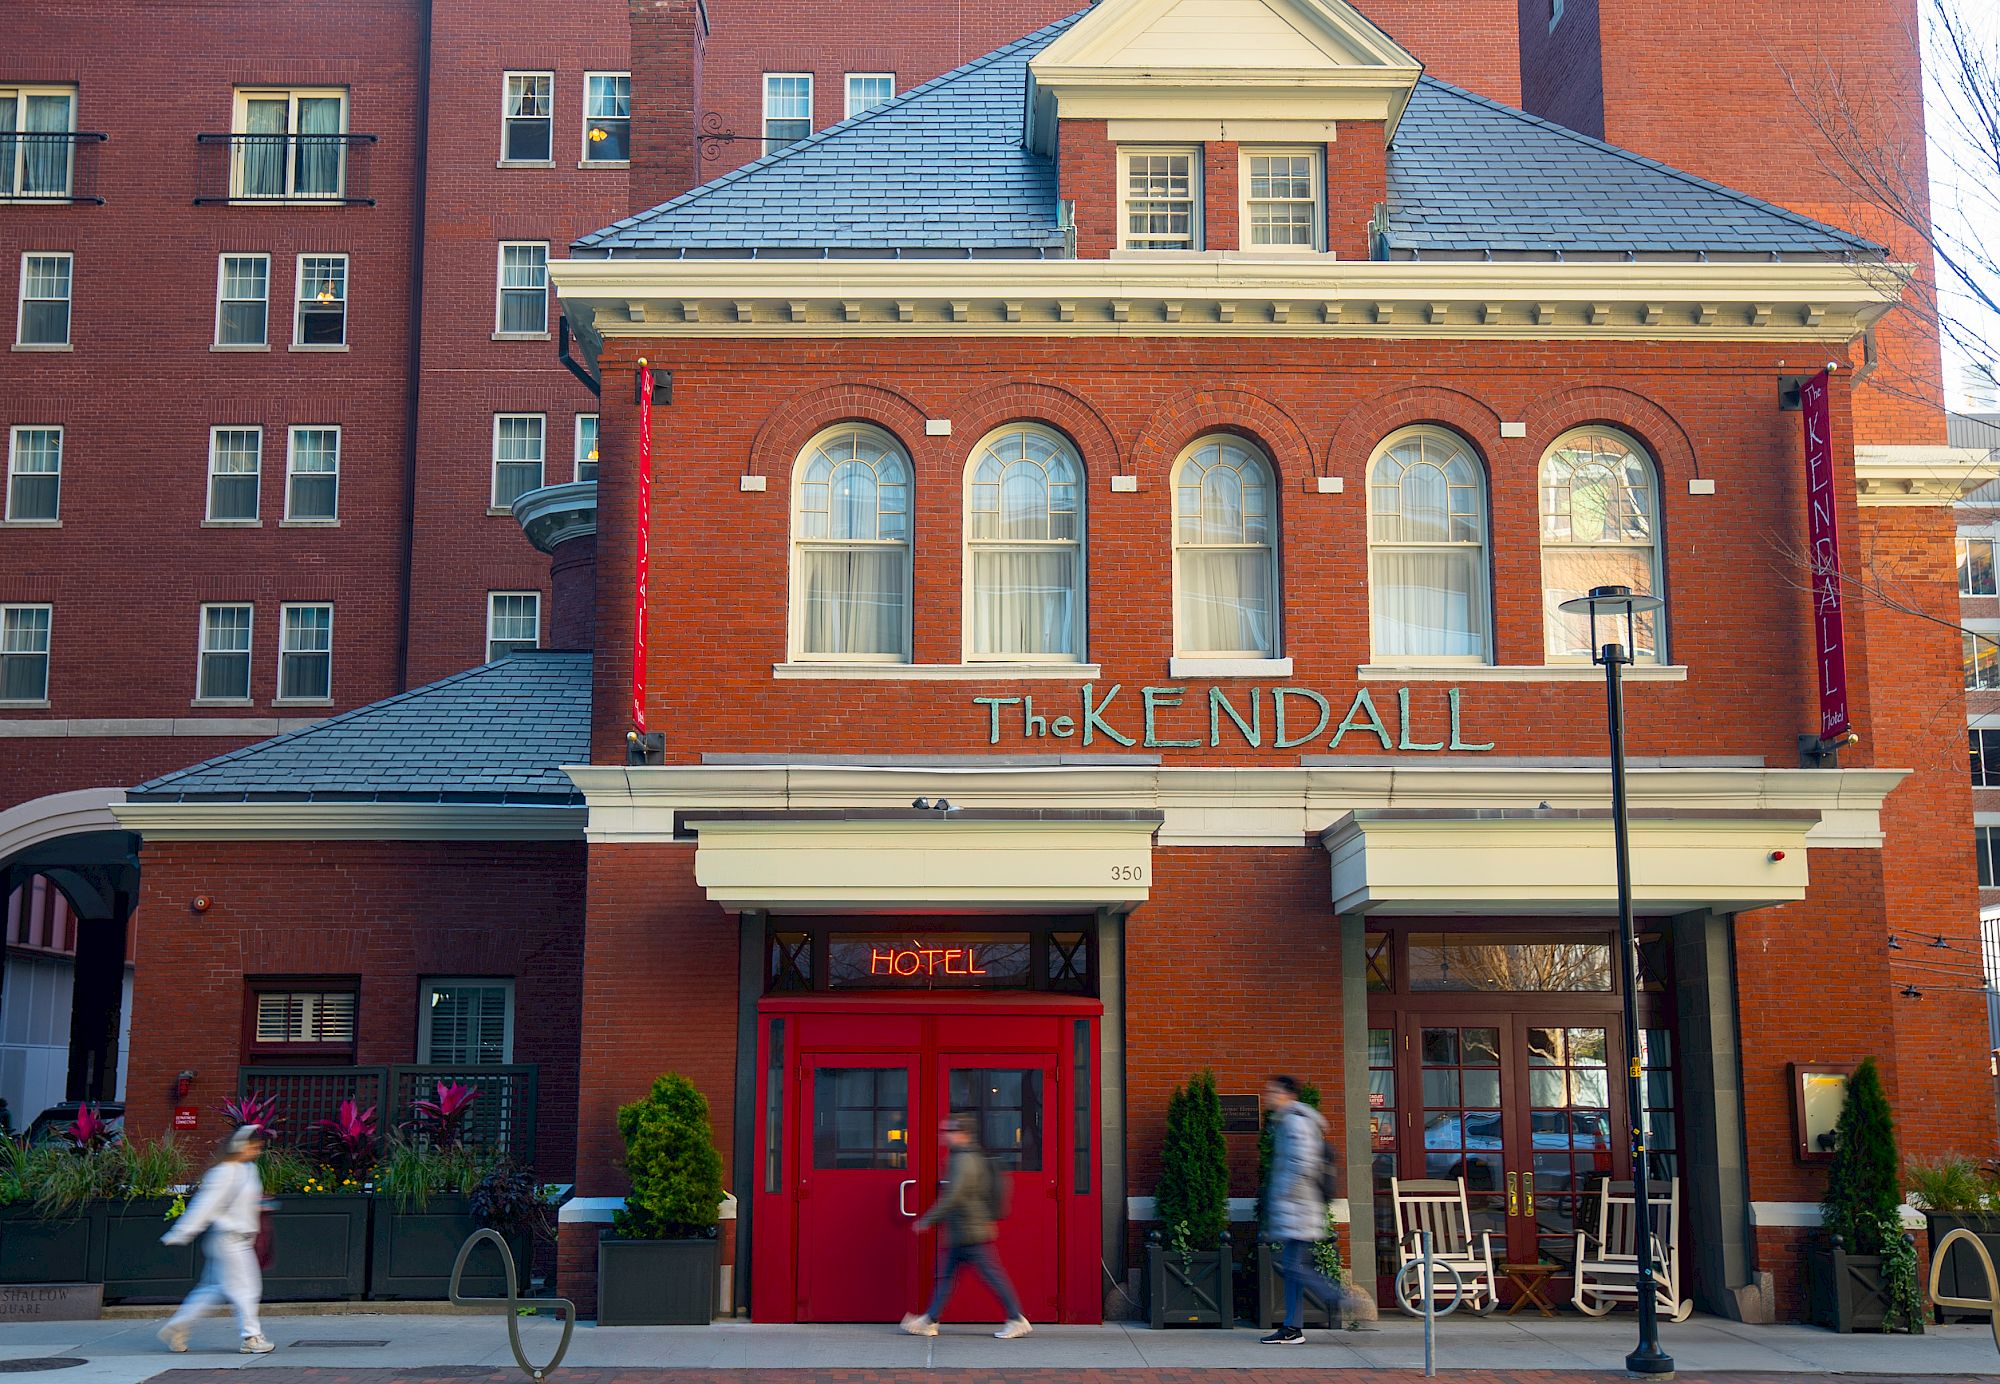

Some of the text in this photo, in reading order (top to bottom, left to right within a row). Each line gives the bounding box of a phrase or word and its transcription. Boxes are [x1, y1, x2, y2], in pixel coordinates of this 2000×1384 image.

[1804, 383, 1822, 407] The
[1808, 411, 1838, 696] KENDALL
[972, 681, 1496, 752] The KENDALL
[1822, 702, 1844, 734] Hotel
[1111, 865, 1143, 881] 350
